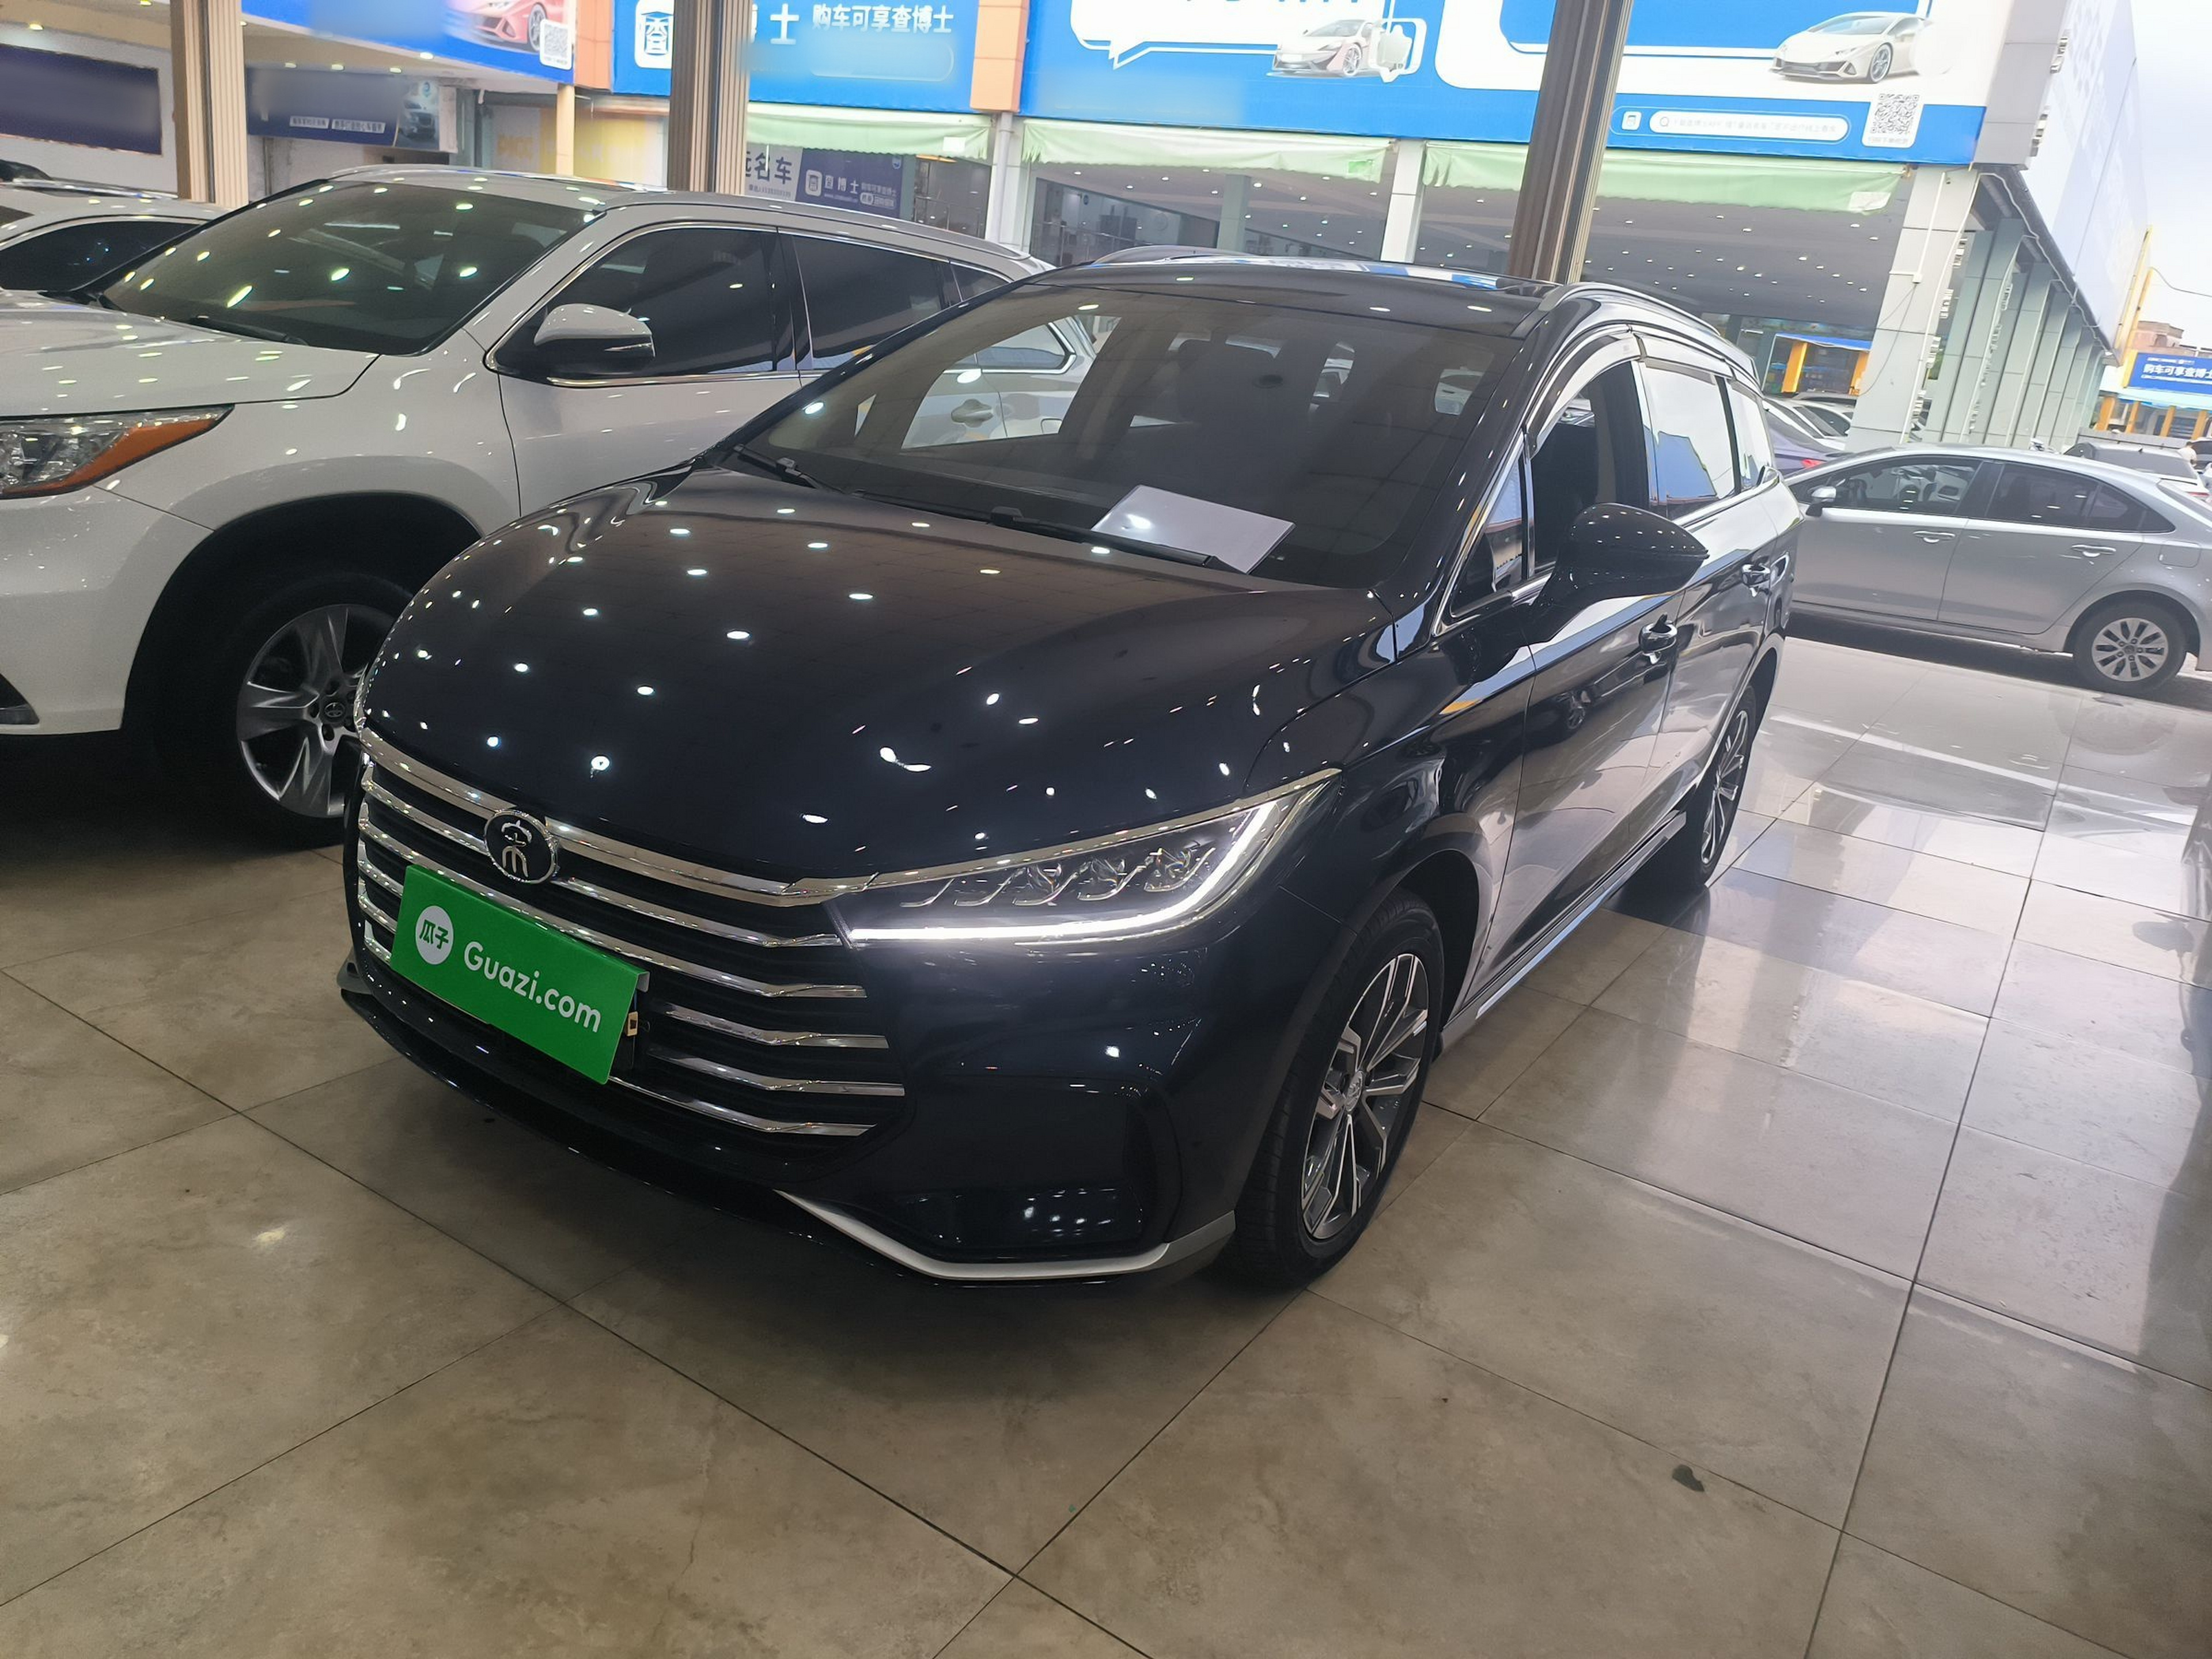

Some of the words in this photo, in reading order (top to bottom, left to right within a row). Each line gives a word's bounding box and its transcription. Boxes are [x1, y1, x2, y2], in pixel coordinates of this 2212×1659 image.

[812, 3, 954, 33] 购车可享查博士
[419, 919, 449, 949] 瓜子
[464, 941, 601, 1033] Guazi.com
